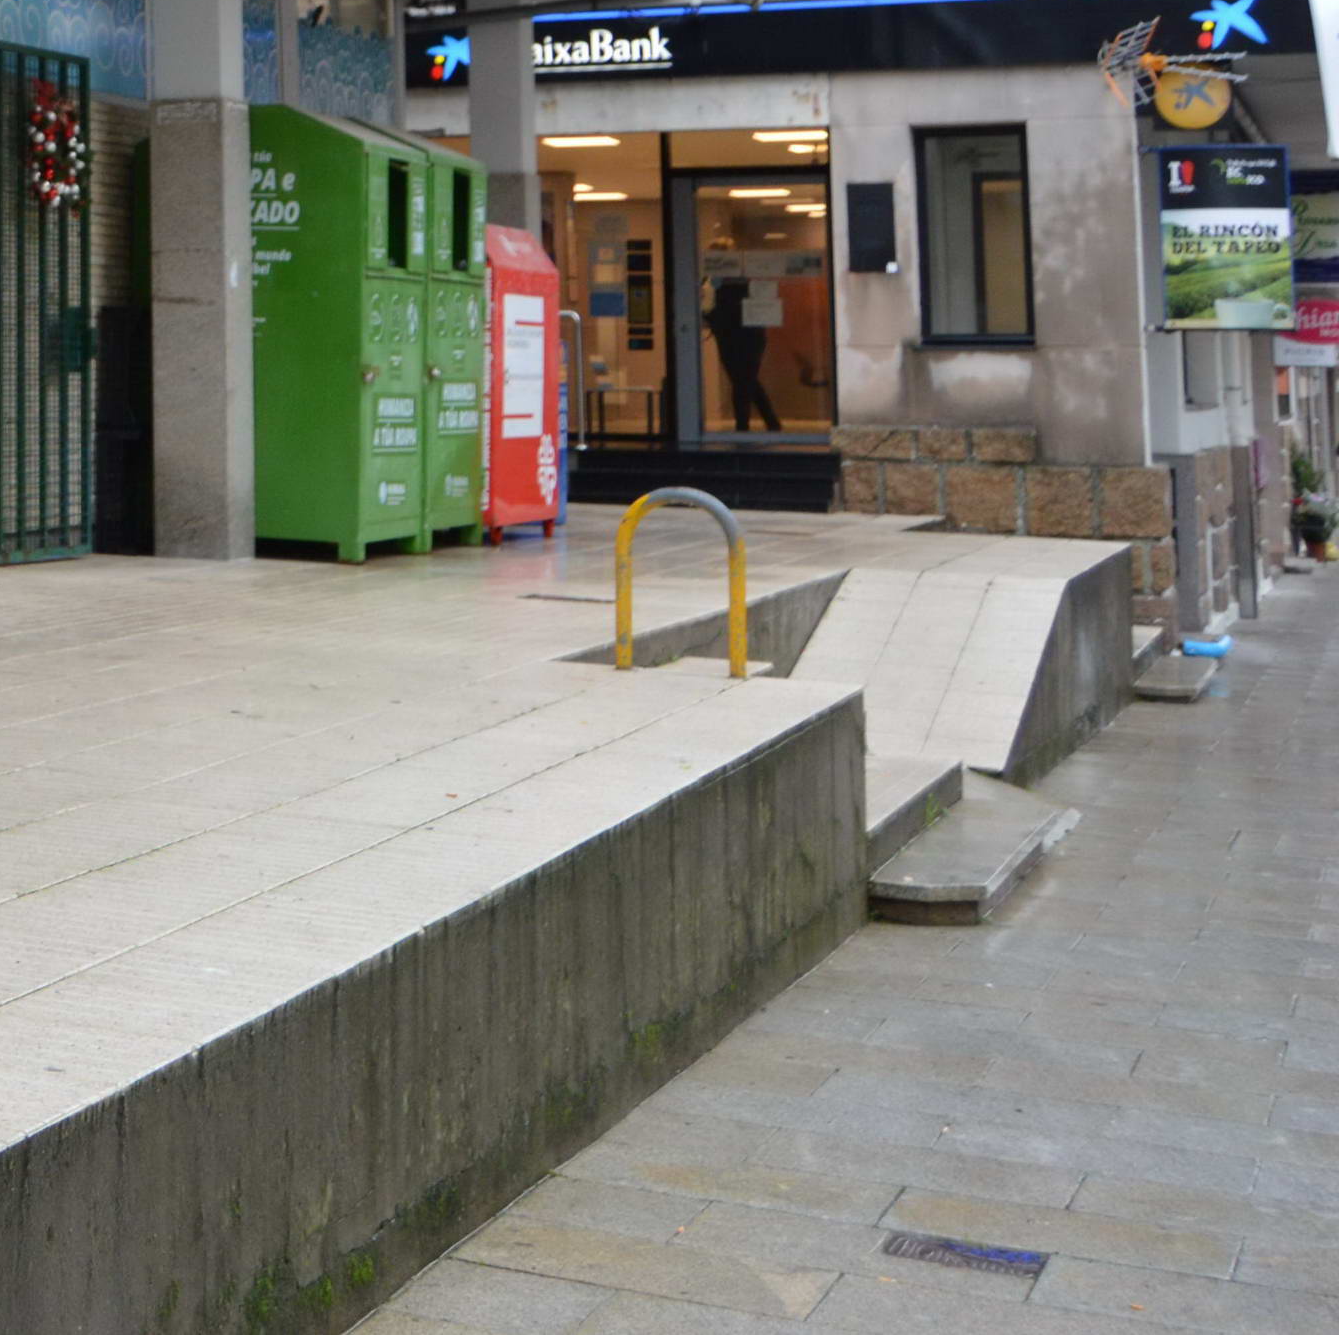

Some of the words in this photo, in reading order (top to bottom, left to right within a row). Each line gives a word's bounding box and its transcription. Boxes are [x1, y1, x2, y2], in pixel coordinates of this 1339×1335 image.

[531, 26, 672, 64] aixaBank
[1172, 225, 1193, 238] EL
[1199, 222, 1279, 237] RINCÓN
[1173, 241, 1206, 254] DEL
[1211, 240, 1280, 254] TAPEO
